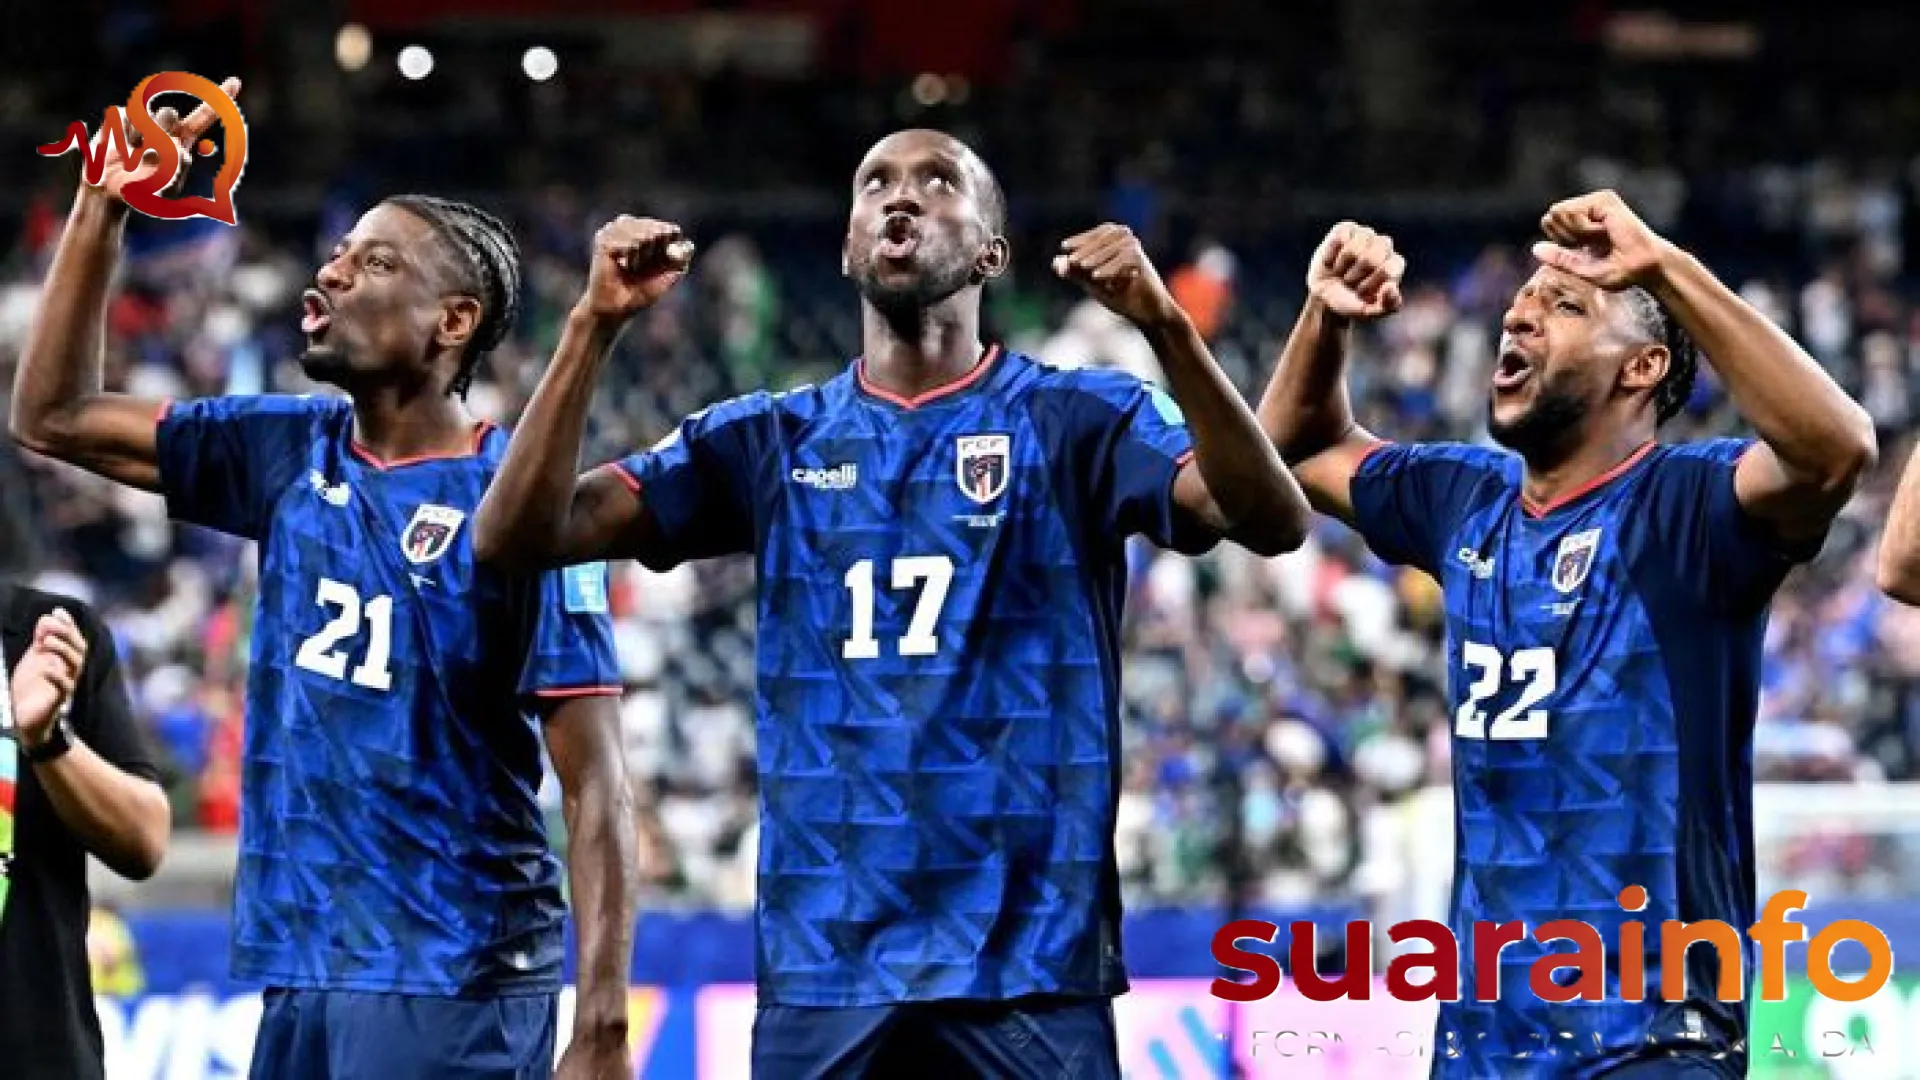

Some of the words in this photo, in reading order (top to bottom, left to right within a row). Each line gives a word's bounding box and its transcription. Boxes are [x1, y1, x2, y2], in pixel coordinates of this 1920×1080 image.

[295, 577, 392, 691] 21
[842, 556, 954, 658] 17
[1456, 641, 1556, 740] 22
